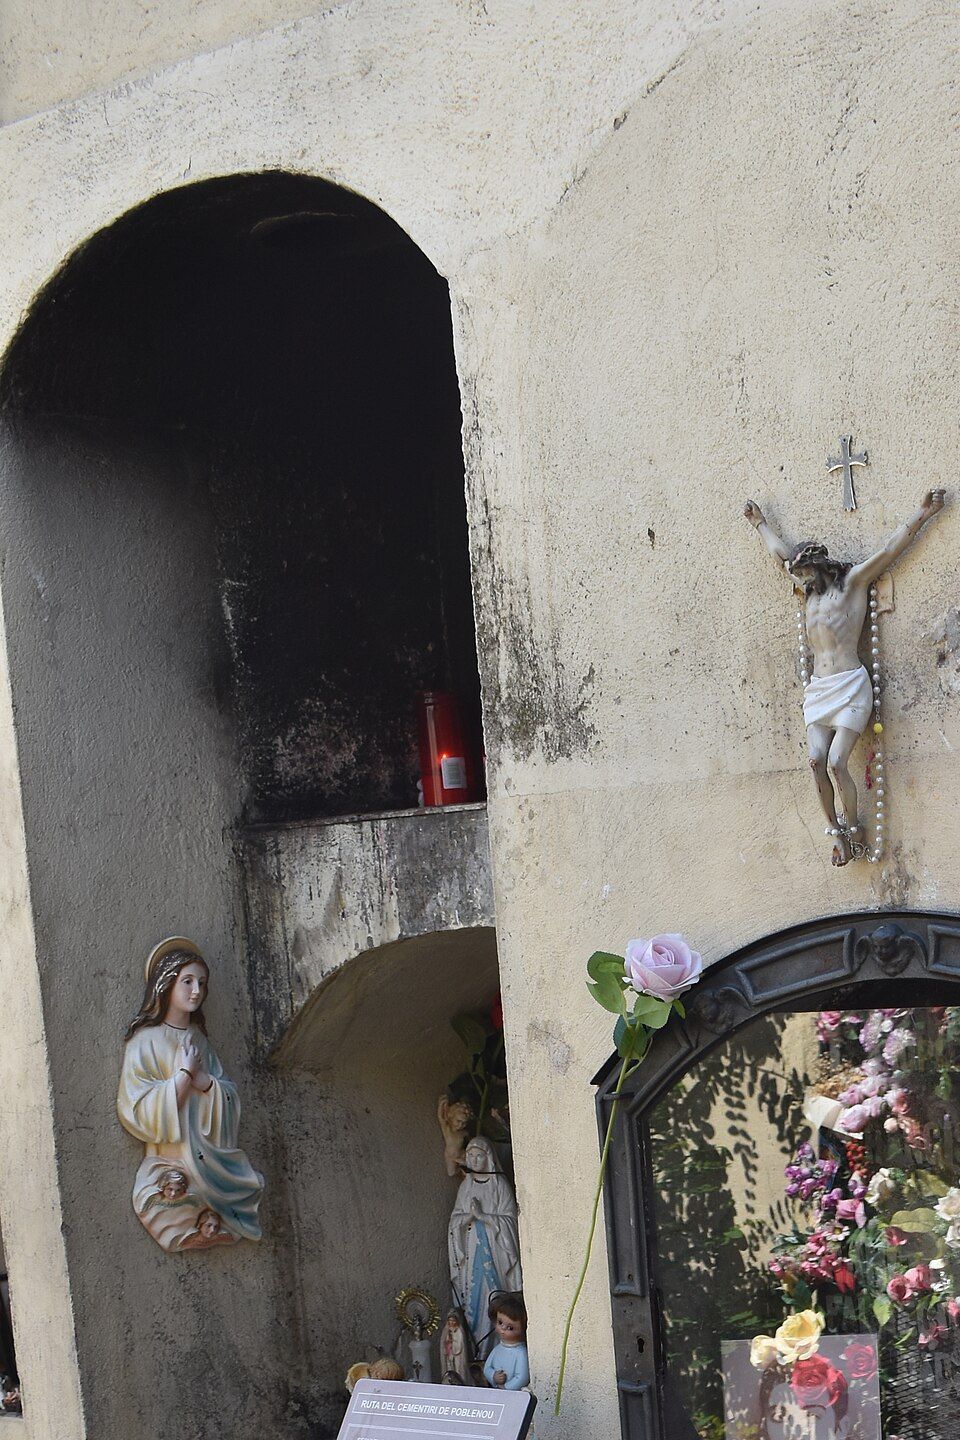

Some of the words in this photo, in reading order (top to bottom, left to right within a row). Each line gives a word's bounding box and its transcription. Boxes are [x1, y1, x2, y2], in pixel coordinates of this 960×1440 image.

[361, 1400, 380, 1410] RUTA
[381, 1402, 396, 1411] DEL
[397, 1403, 438, 1415] CEMENTIRI
[438, 1407, 450, 1416] DE
[451, 1407, 494, 1419] POBLENOU
